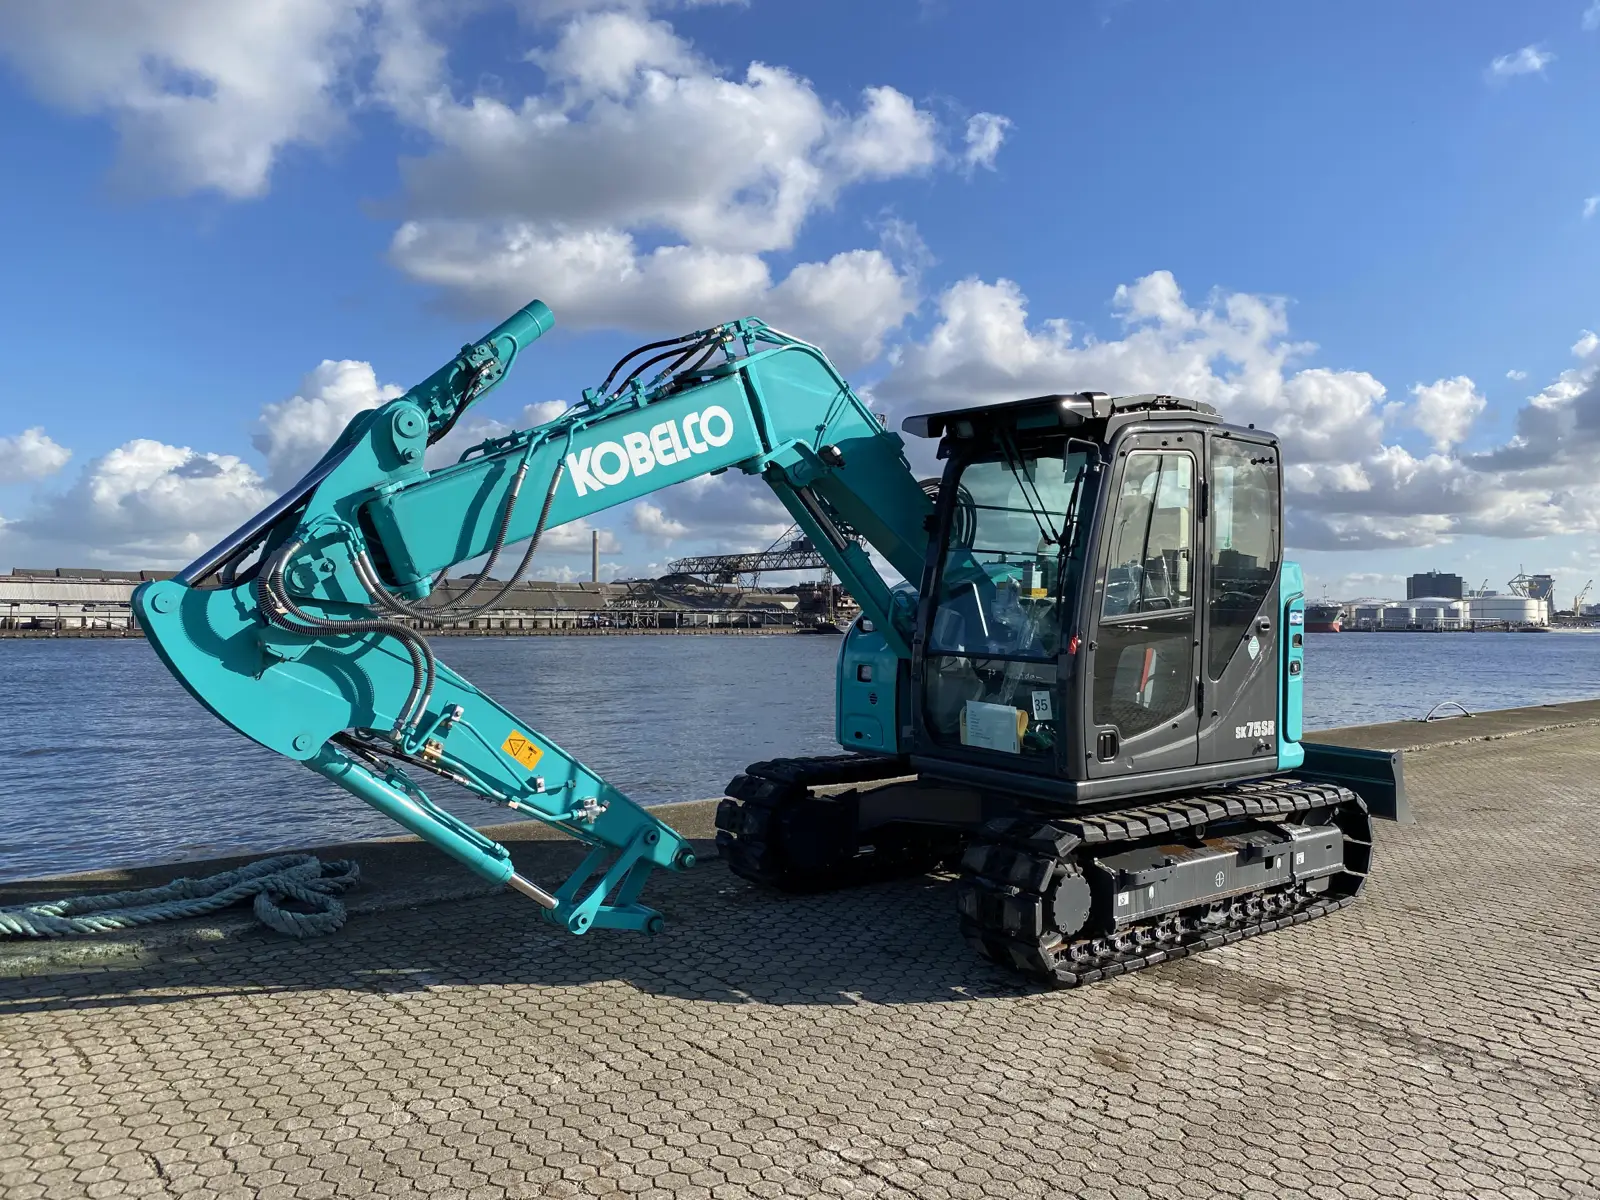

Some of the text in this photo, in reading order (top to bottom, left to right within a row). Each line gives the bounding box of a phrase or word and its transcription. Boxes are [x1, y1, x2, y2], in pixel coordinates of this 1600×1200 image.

[566, 405, 734, 497] KOBELCO
[1035, 698, 1048, 711] 35
[1235, 720, 1275, 739] SK75SR
